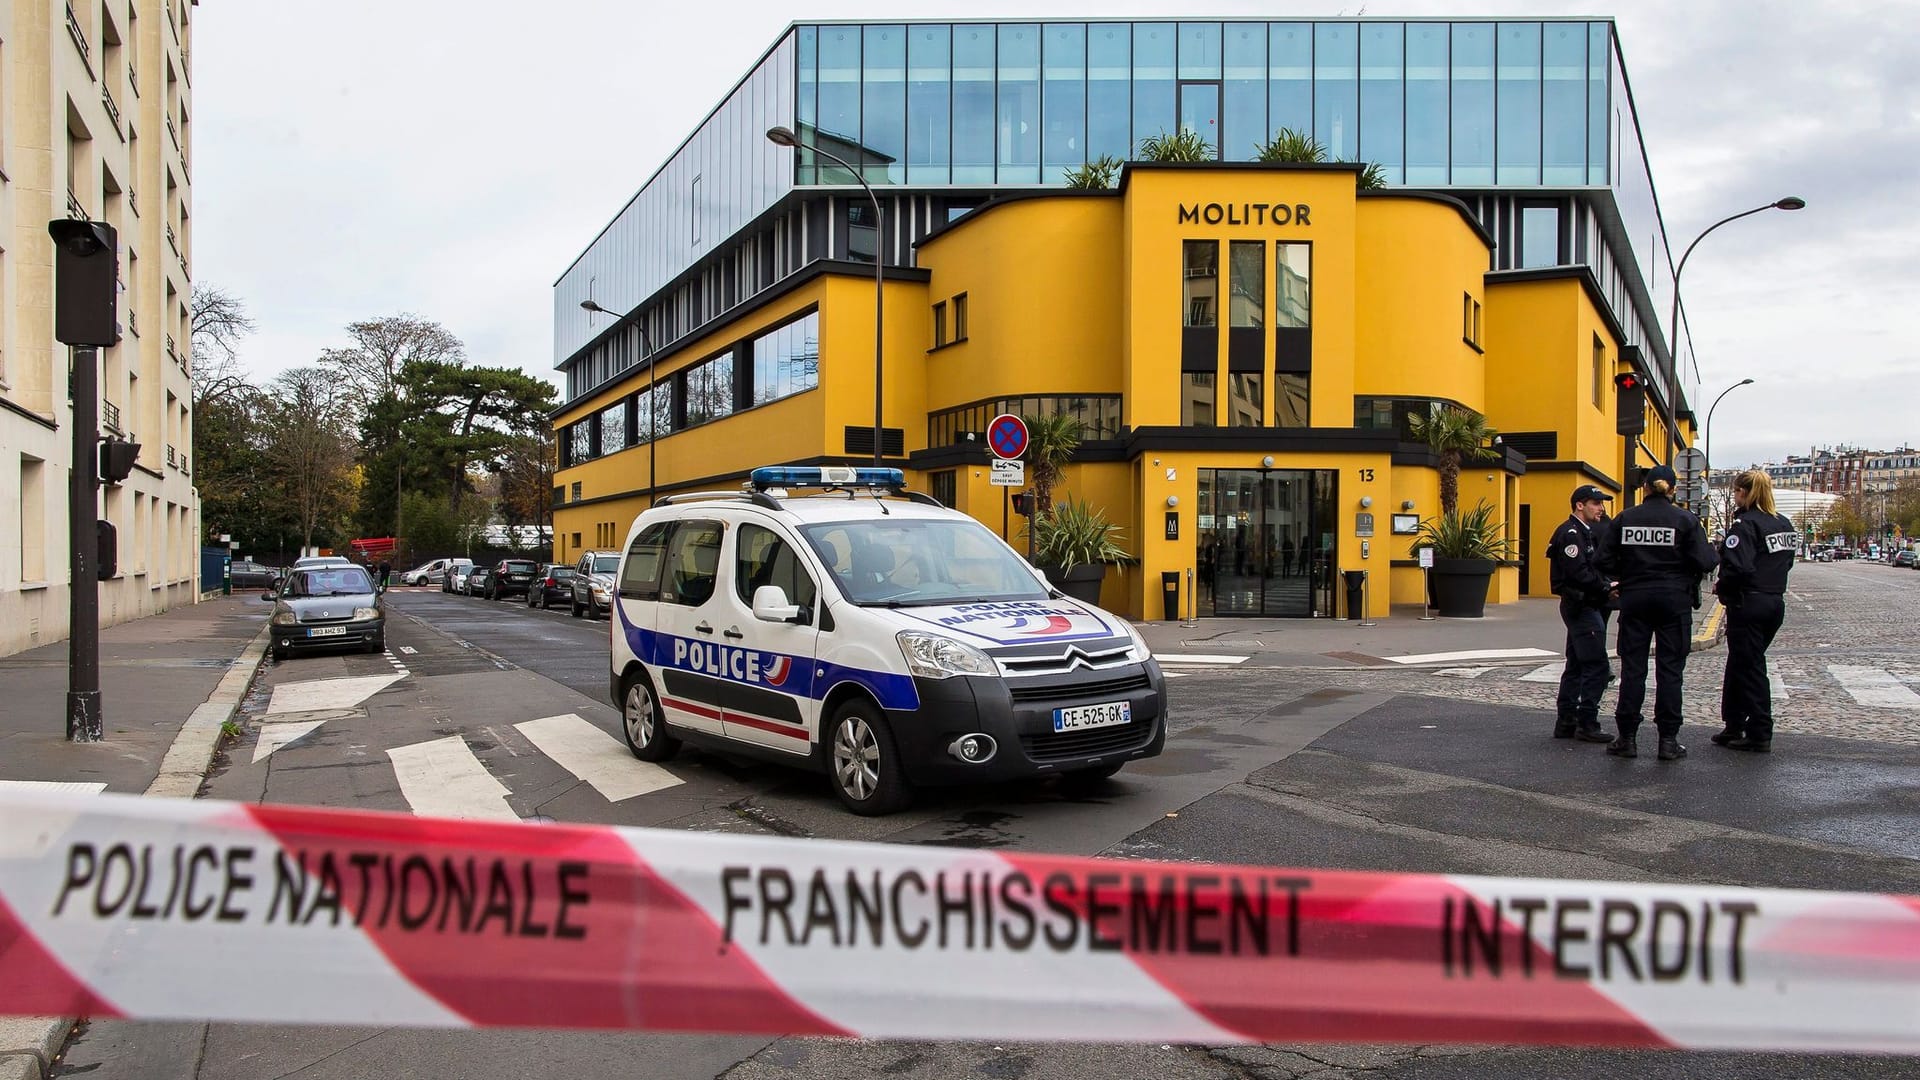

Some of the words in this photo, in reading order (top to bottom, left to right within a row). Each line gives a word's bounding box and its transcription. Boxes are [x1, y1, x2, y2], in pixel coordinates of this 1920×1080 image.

[1178, 202, 1312, 226] MOLITOR
[1359, 469, 1374, 482] 13
[1625, 529, 1671, 543] POLICE
[1768, 534, 1796, 549] POICE
[952, 602, 1046, 613] POLICE
[938, 609, 1088, 625] NATIONALE
[674, 638, 760, 682] POLICE
[1064, 704, 1121, 727] CE-525-GK
[51, 841, 256, 923] POLICE
[266, 845, 592, 941] NATIONALE
[720, 866, 1313, 957] FRANCHISSEMENT
[1441, 897, 1760, 984] INTERDIT
